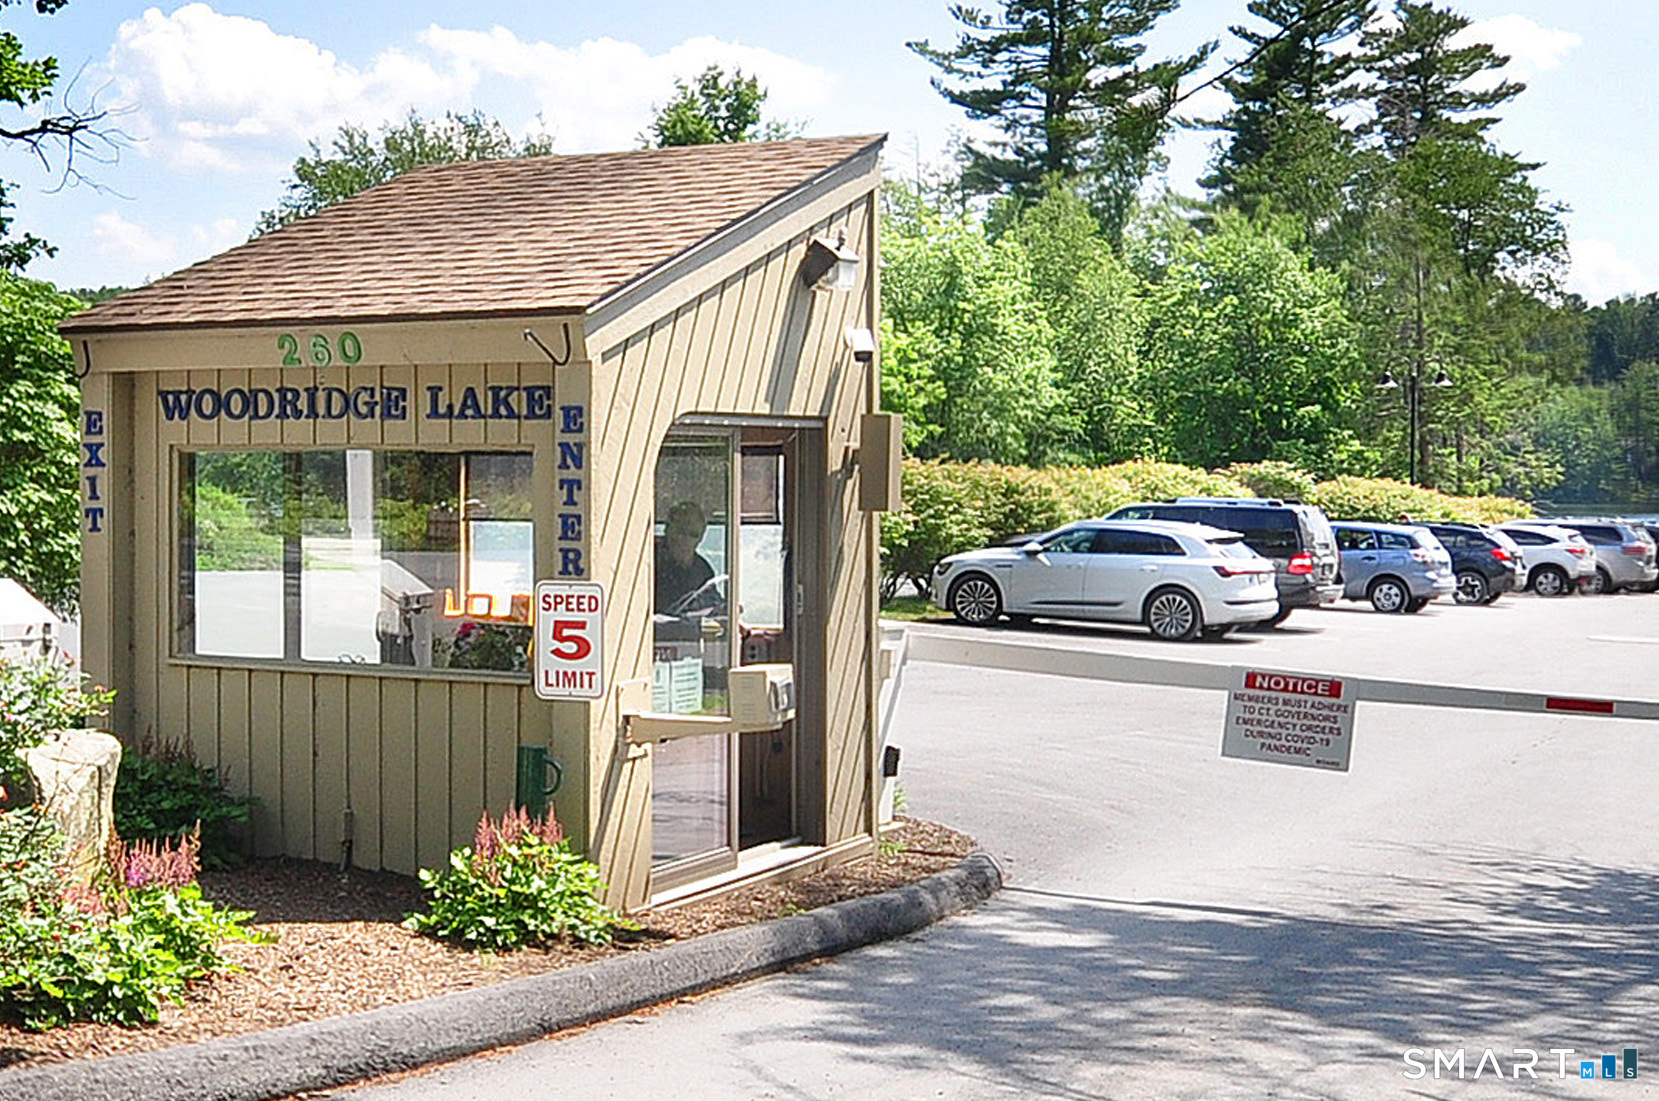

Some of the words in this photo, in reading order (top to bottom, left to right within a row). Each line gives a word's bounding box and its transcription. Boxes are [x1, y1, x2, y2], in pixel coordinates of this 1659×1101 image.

[277, 331, 362, 367] 260
[158, 386, 407, 420] WOODRIDGE
[426, 384, 552, 420] LAKE
[82, 410, 106, 532] EXIT
[557, 405, 585, 577] ENTER
[541, 593, 599, 613] SPEED
[550, 620, 591, 660] 5
[544, 669, 596, 689] LIMIT
[1255, 674, 1331, 695] NOTICE
[1233, 692, 1280, 706] MEMBERS
[1282, 698, 1308, 709] MUST
[1310, 700, 1349, 714] ADHERE
[1242, 704, 1256, 715] TO
[1235, 716, 1298, 732] EMERGENCY
[1300, 723, 1342, 736] ORDERS
[1244, 729, 1283, 742] DURING
[1284, 733, 1331, 747] COVID-19
[1260, 742, 1312, 757] PANDEMIC
